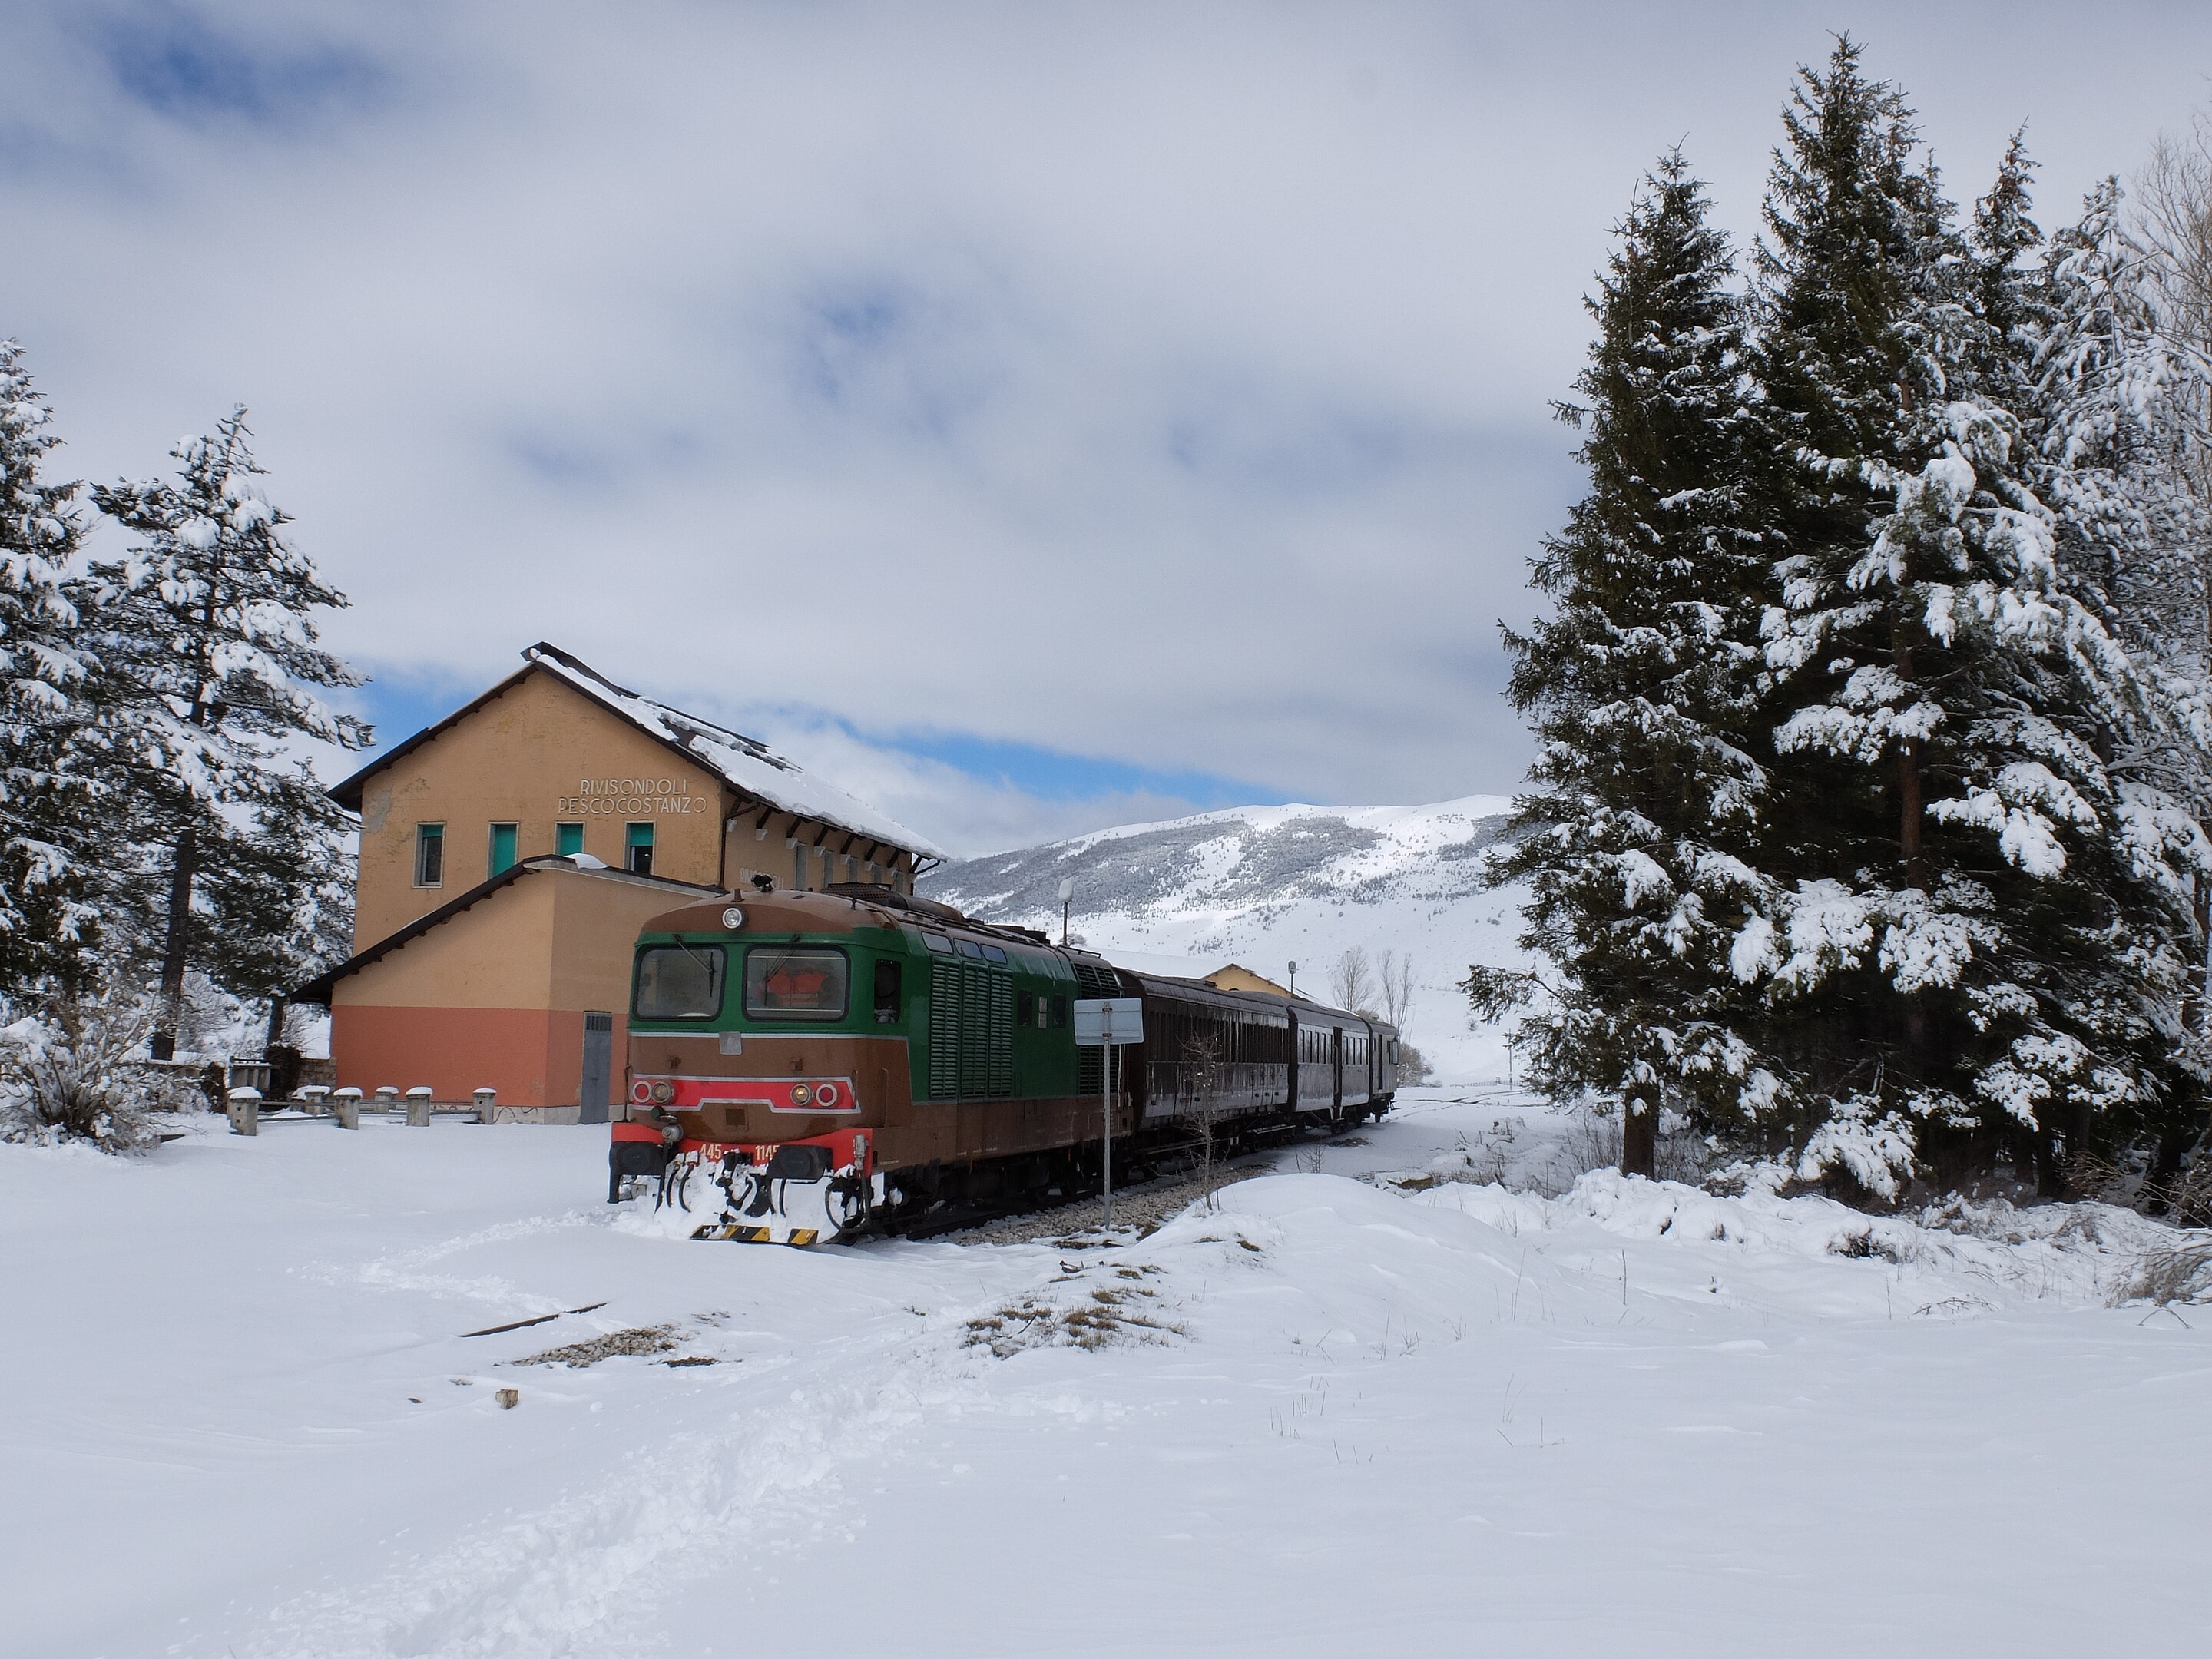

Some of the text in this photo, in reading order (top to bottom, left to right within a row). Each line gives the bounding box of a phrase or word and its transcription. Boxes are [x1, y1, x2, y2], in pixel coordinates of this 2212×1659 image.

[580, 778, 687, 796] RIVISONDOLI
[558, 796, 707, 814] PESCOCOSTANZO
[700, 1144, 722, 1159] 445
